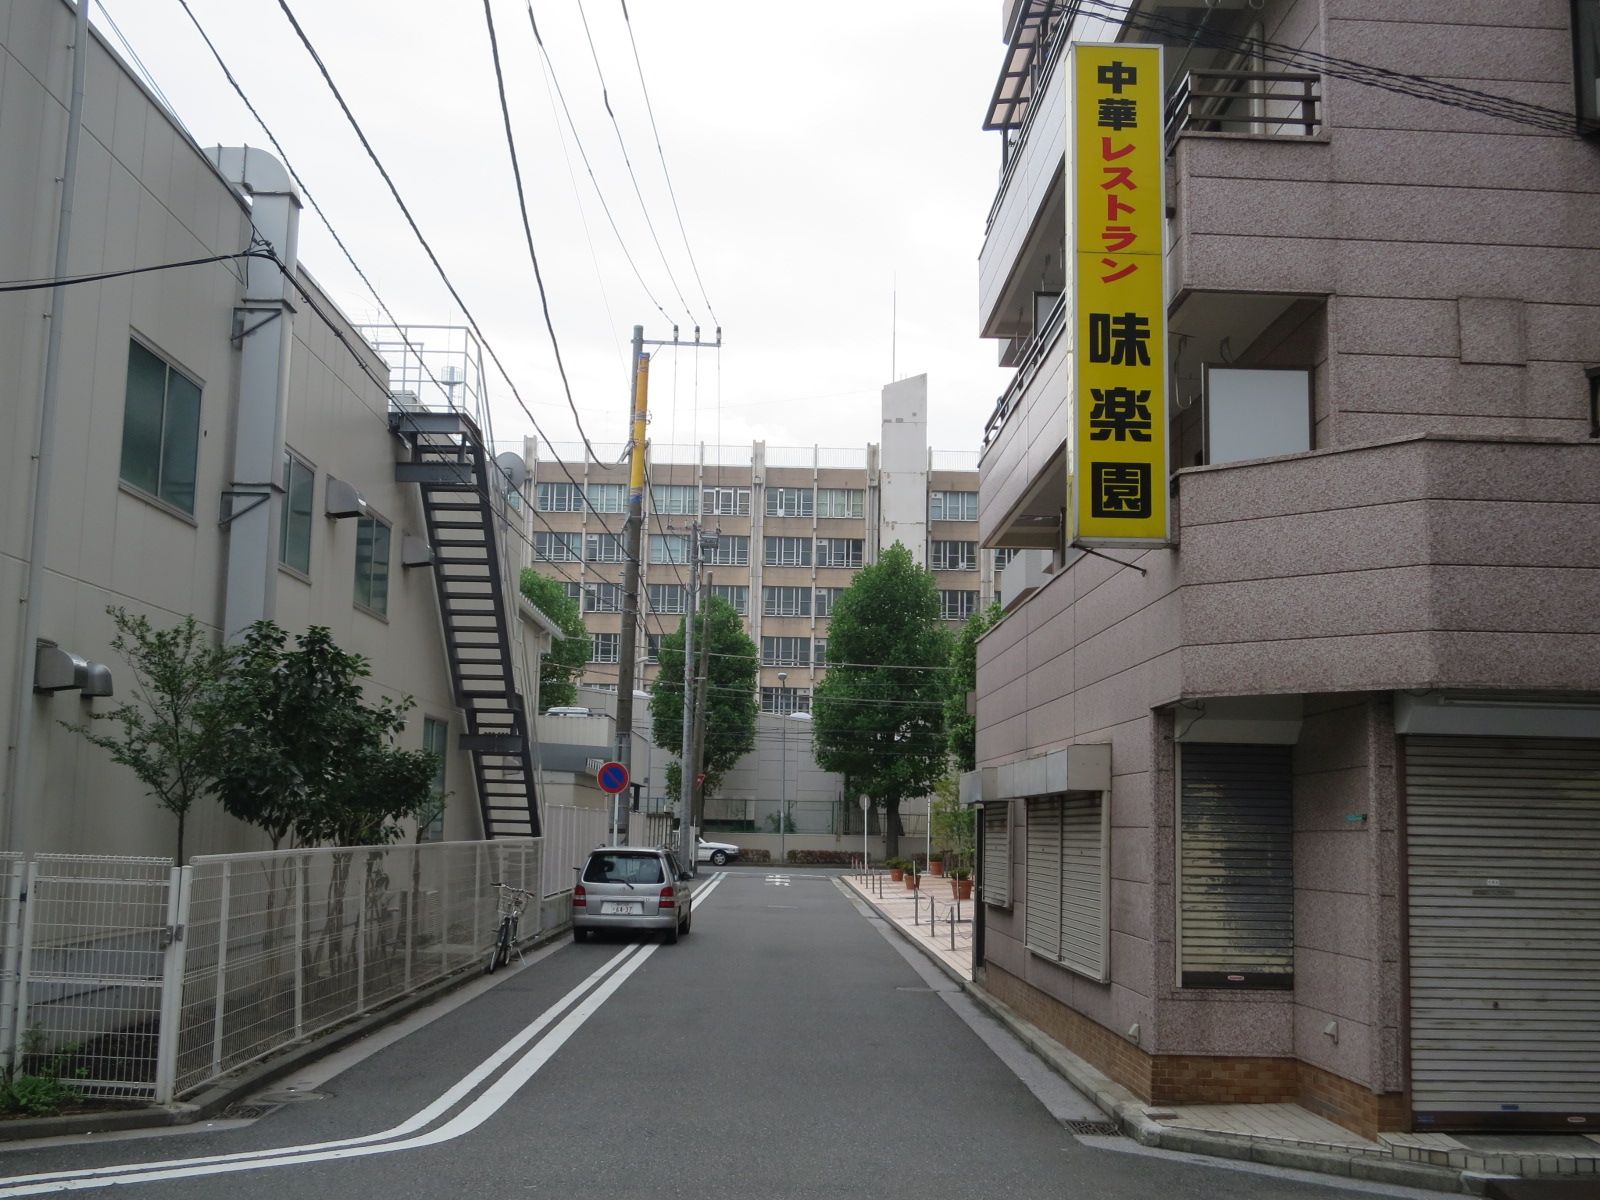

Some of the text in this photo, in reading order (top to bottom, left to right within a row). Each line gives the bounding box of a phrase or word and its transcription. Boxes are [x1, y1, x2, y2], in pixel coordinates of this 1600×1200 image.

[1097, 60, 1138, 284] 中華レストラン
[1089, 312, 1152, 519] 味楽園
